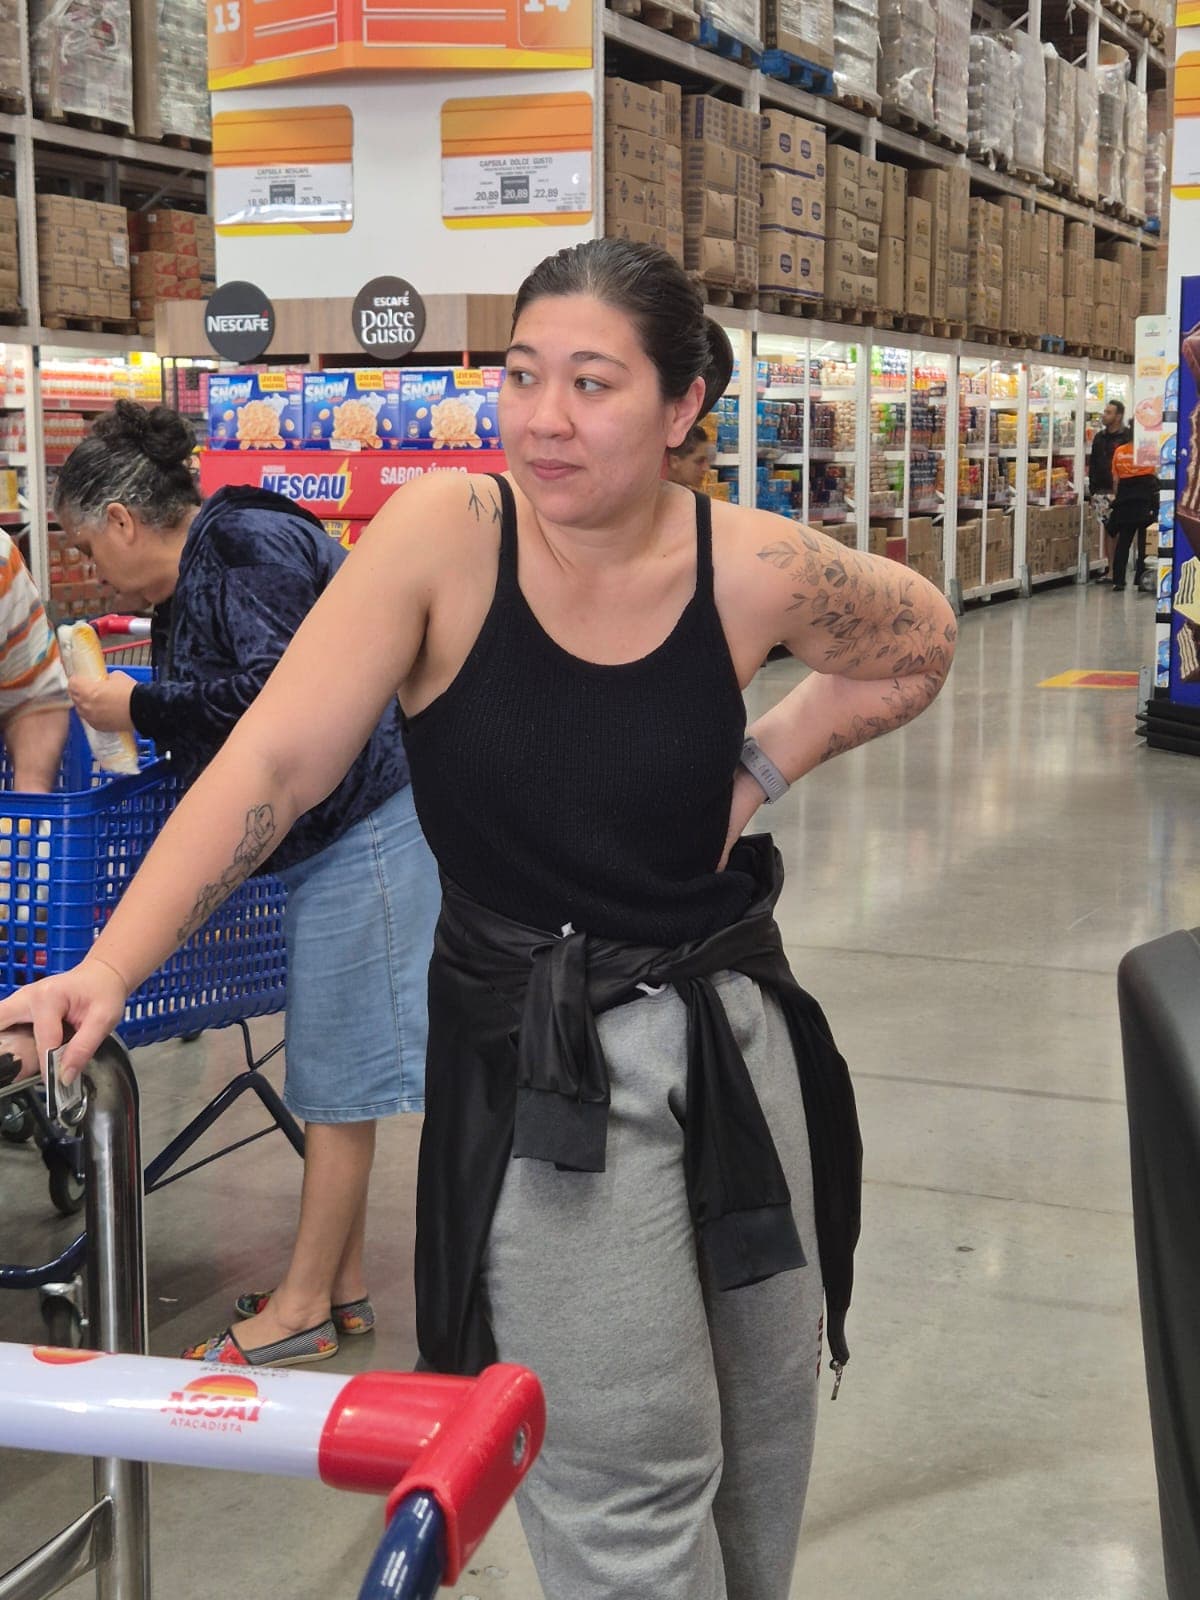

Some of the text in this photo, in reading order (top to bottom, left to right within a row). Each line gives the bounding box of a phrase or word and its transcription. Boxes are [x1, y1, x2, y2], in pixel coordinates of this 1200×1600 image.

[214, 2, 241, 34] 13
[360, 308, 415, 329] Dolce
[361, 327, 416, 345] Gusto
[209, 380, 253, 404] SNOW
[305, 378, 349, 403] SNOW
[402, 376, 448, 401] SNOW
[262, 474, 347, 500] NESCAU
[169, 1416, 243, 1433] ATACADISTA
